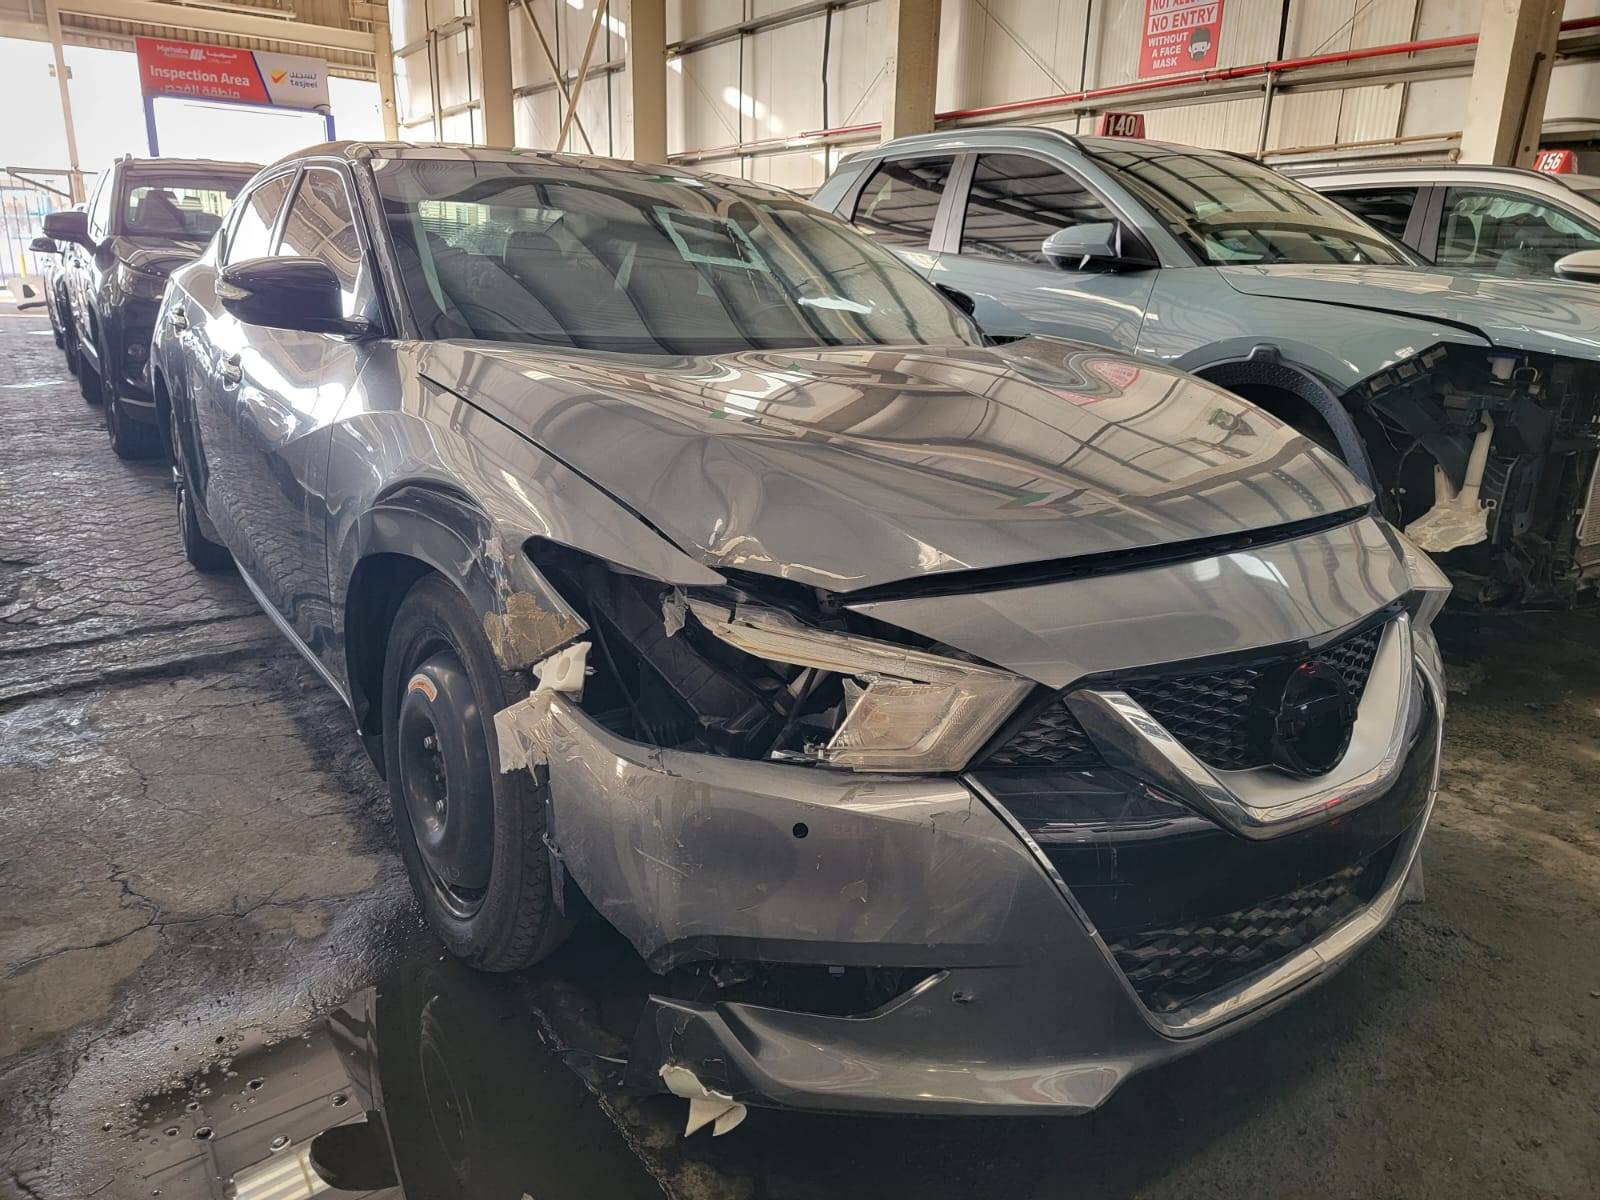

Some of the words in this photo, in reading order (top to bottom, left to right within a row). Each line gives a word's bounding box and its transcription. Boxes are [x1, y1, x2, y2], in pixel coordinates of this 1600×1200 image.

[1151, 16, 1169, 33] NO
[1172, 6, 1215, 28] ENTRY
[1148, 31, 1189, 47] WITHOUT
[1152, 49, 1158, 58] A
[1160, 45, 1182, 57] FACE
[1152, 57, 1178, 70] MASK
[150, 65, 219, 83] Inspection
[221, 73, 250, 87] Area
[290, 79, 318, 89] tasjeel
[1108, 114, 1136, 136] 140
[1538, 152, 1564, 170] 156
